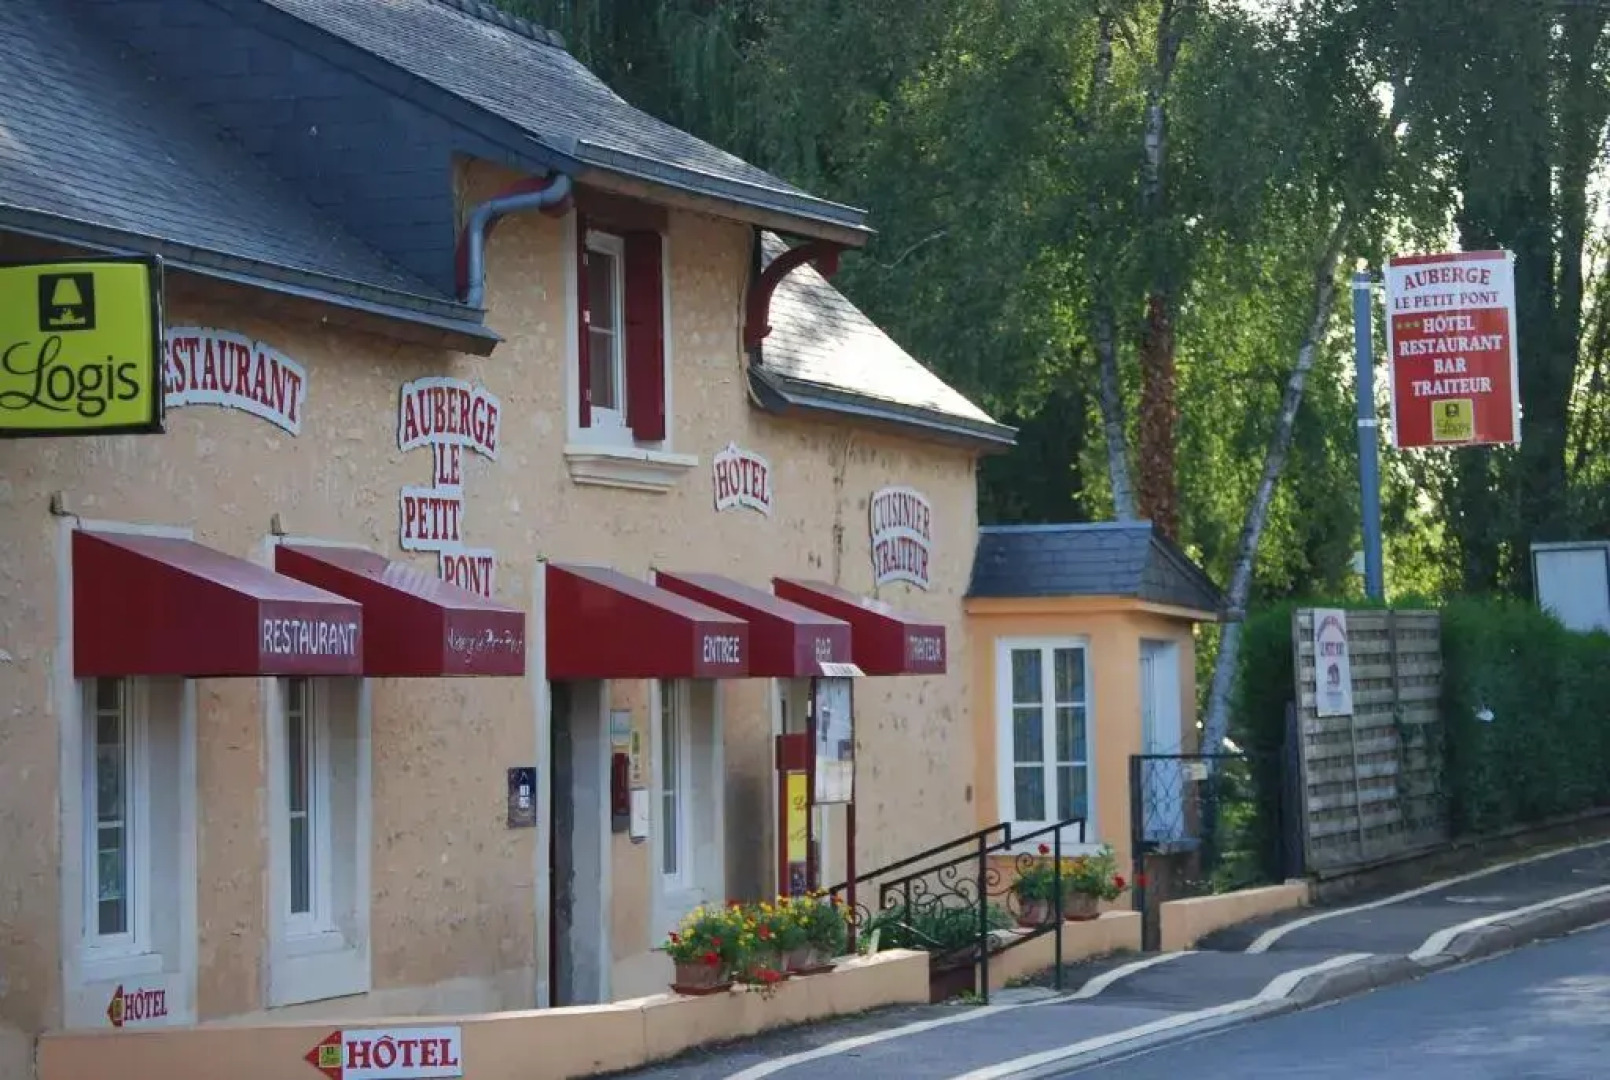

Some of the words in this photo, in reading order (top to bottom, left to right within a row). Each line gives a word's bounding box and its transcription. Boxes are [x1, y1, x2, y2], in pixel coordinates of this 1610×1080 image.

[1404, 267, 1491, 291] AUBERGE
[1395, 298, 1410, 310] LE
[1415, 293, 1455, 309] PETIT
[1460, 291, 1499, 306] PONT
[1399, 335, 1503, 356] RESTAURANT
[0, 335, 140, 417] Logis
[164, 337, 301, 424] ESTAURANT
[1434, 358, 1467, 374] BAR
[1412, 377, 1492, 397] TRAITEUR
[404, 387, 498, 452] AUBERGE
[439, 443, 459, 485] LE
[404, 497, 460, 541] PETIT
[874, 492, 930, 541] CUISINIER
[444, 556, 492, 598] PONT
[876, 536, 929, 583] TRAITEUR
[263, 619, 357, 655] RESTAURANT
[124, 987, 168, 1020] HÔTEL
[346, 1036, 457, 1069] HÔTEL
